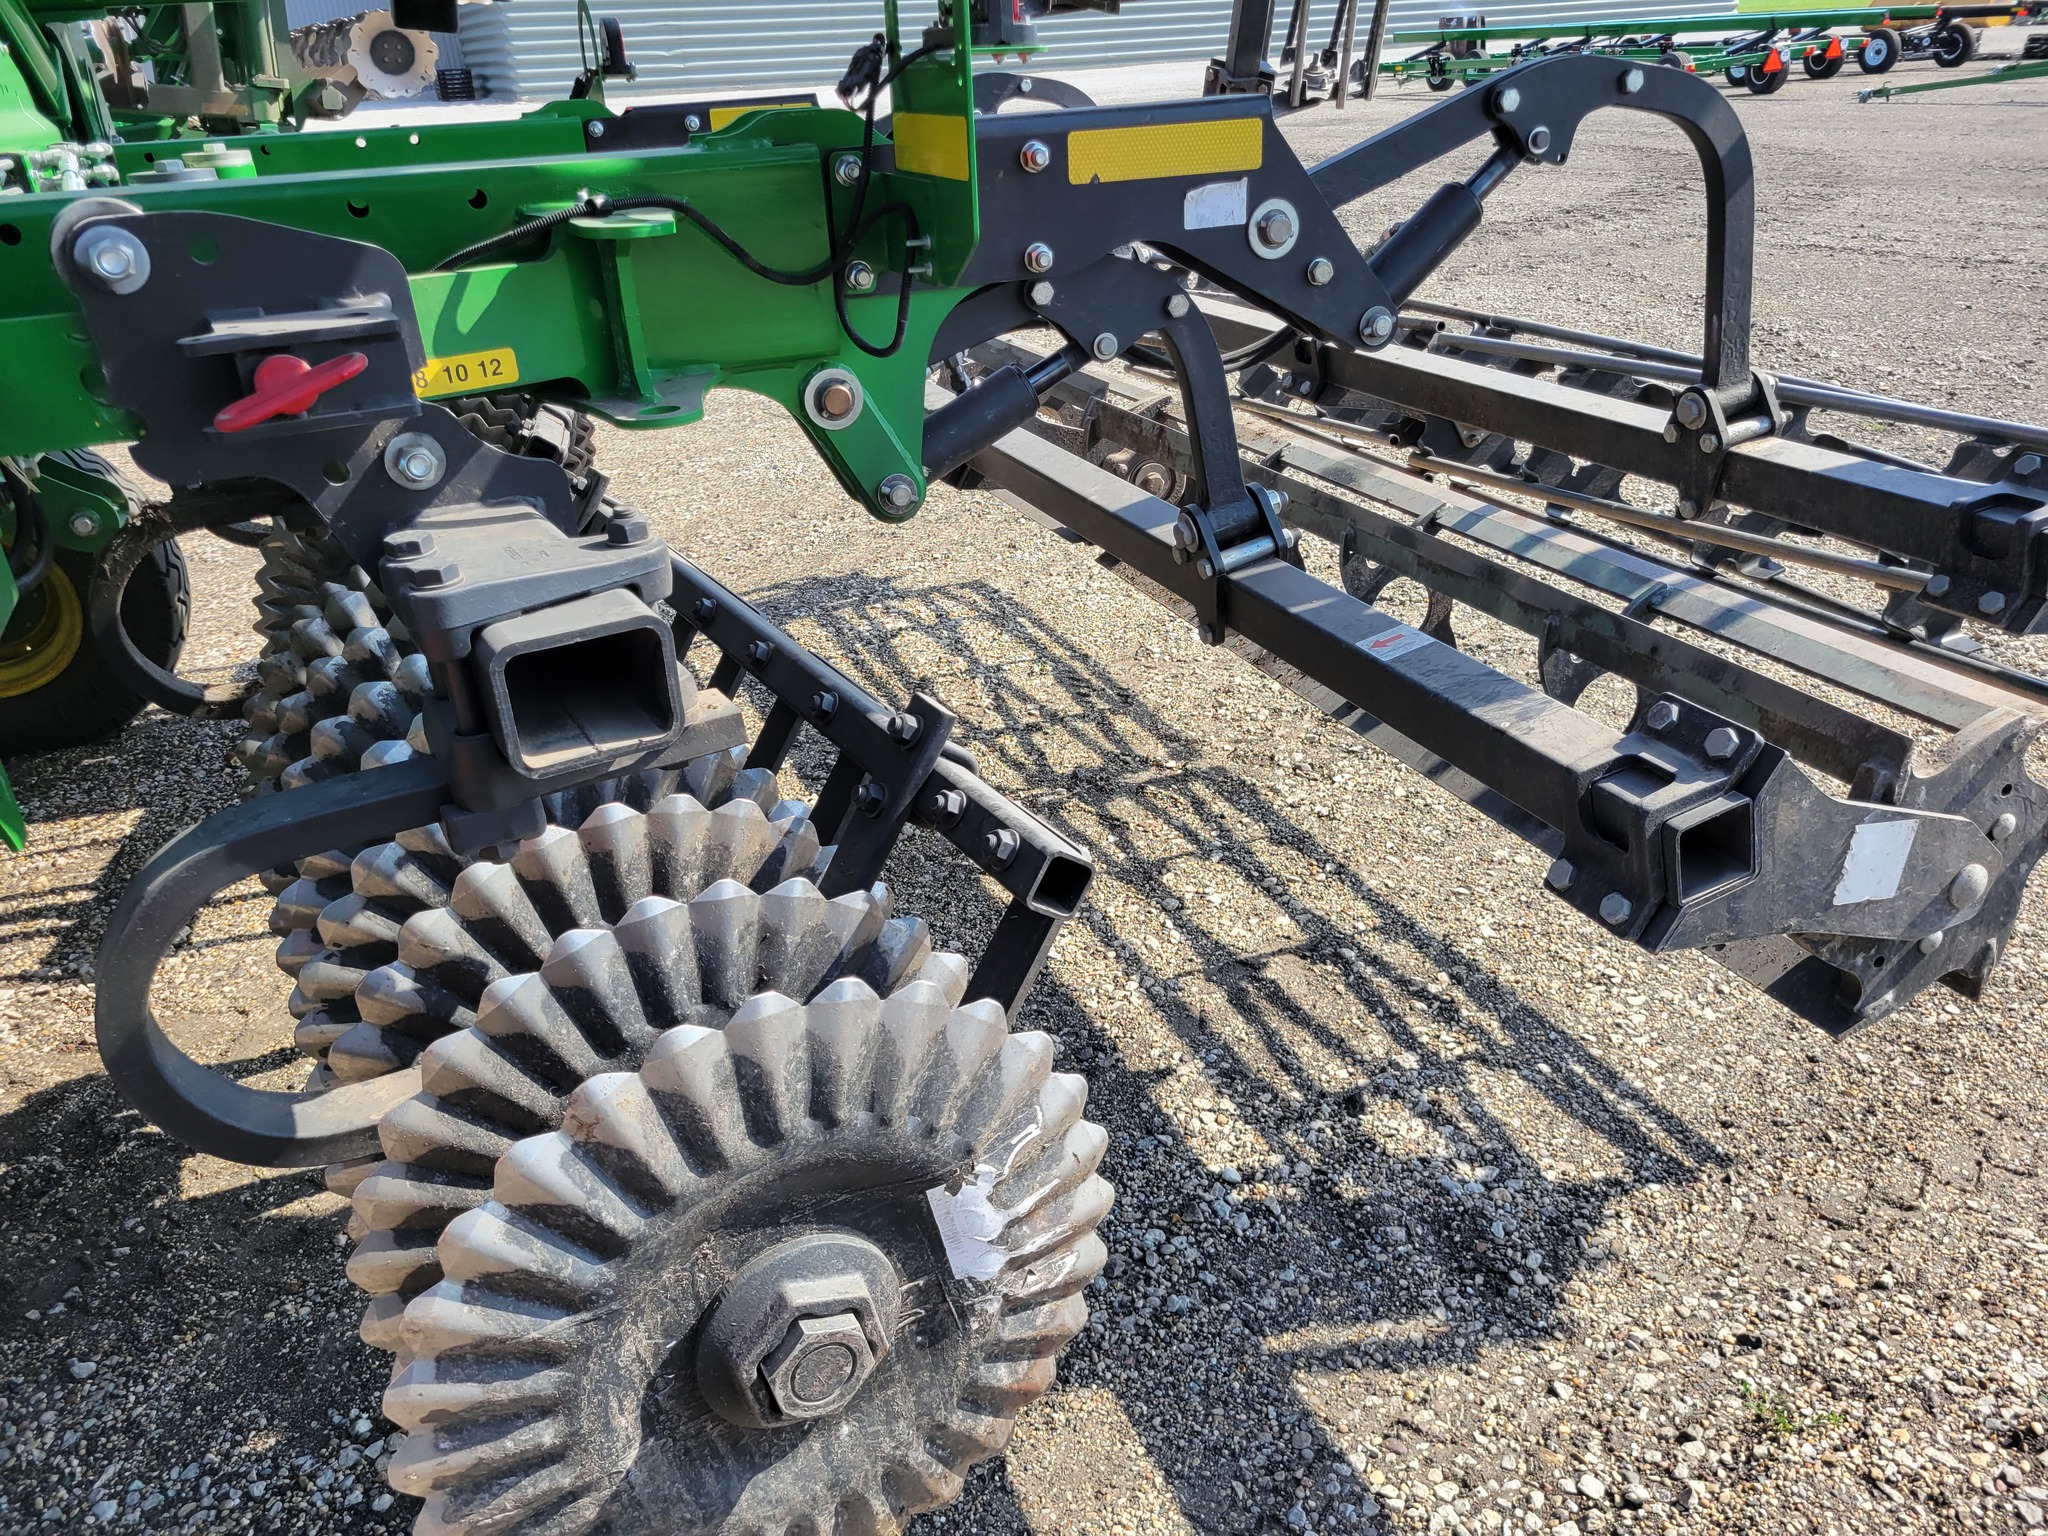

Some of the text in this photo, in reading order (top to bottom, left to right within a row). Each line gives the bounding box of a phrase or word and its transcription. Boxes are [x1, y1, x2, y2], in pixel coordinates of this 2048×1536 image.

[415, 358, 503, 388] 8 10 12
